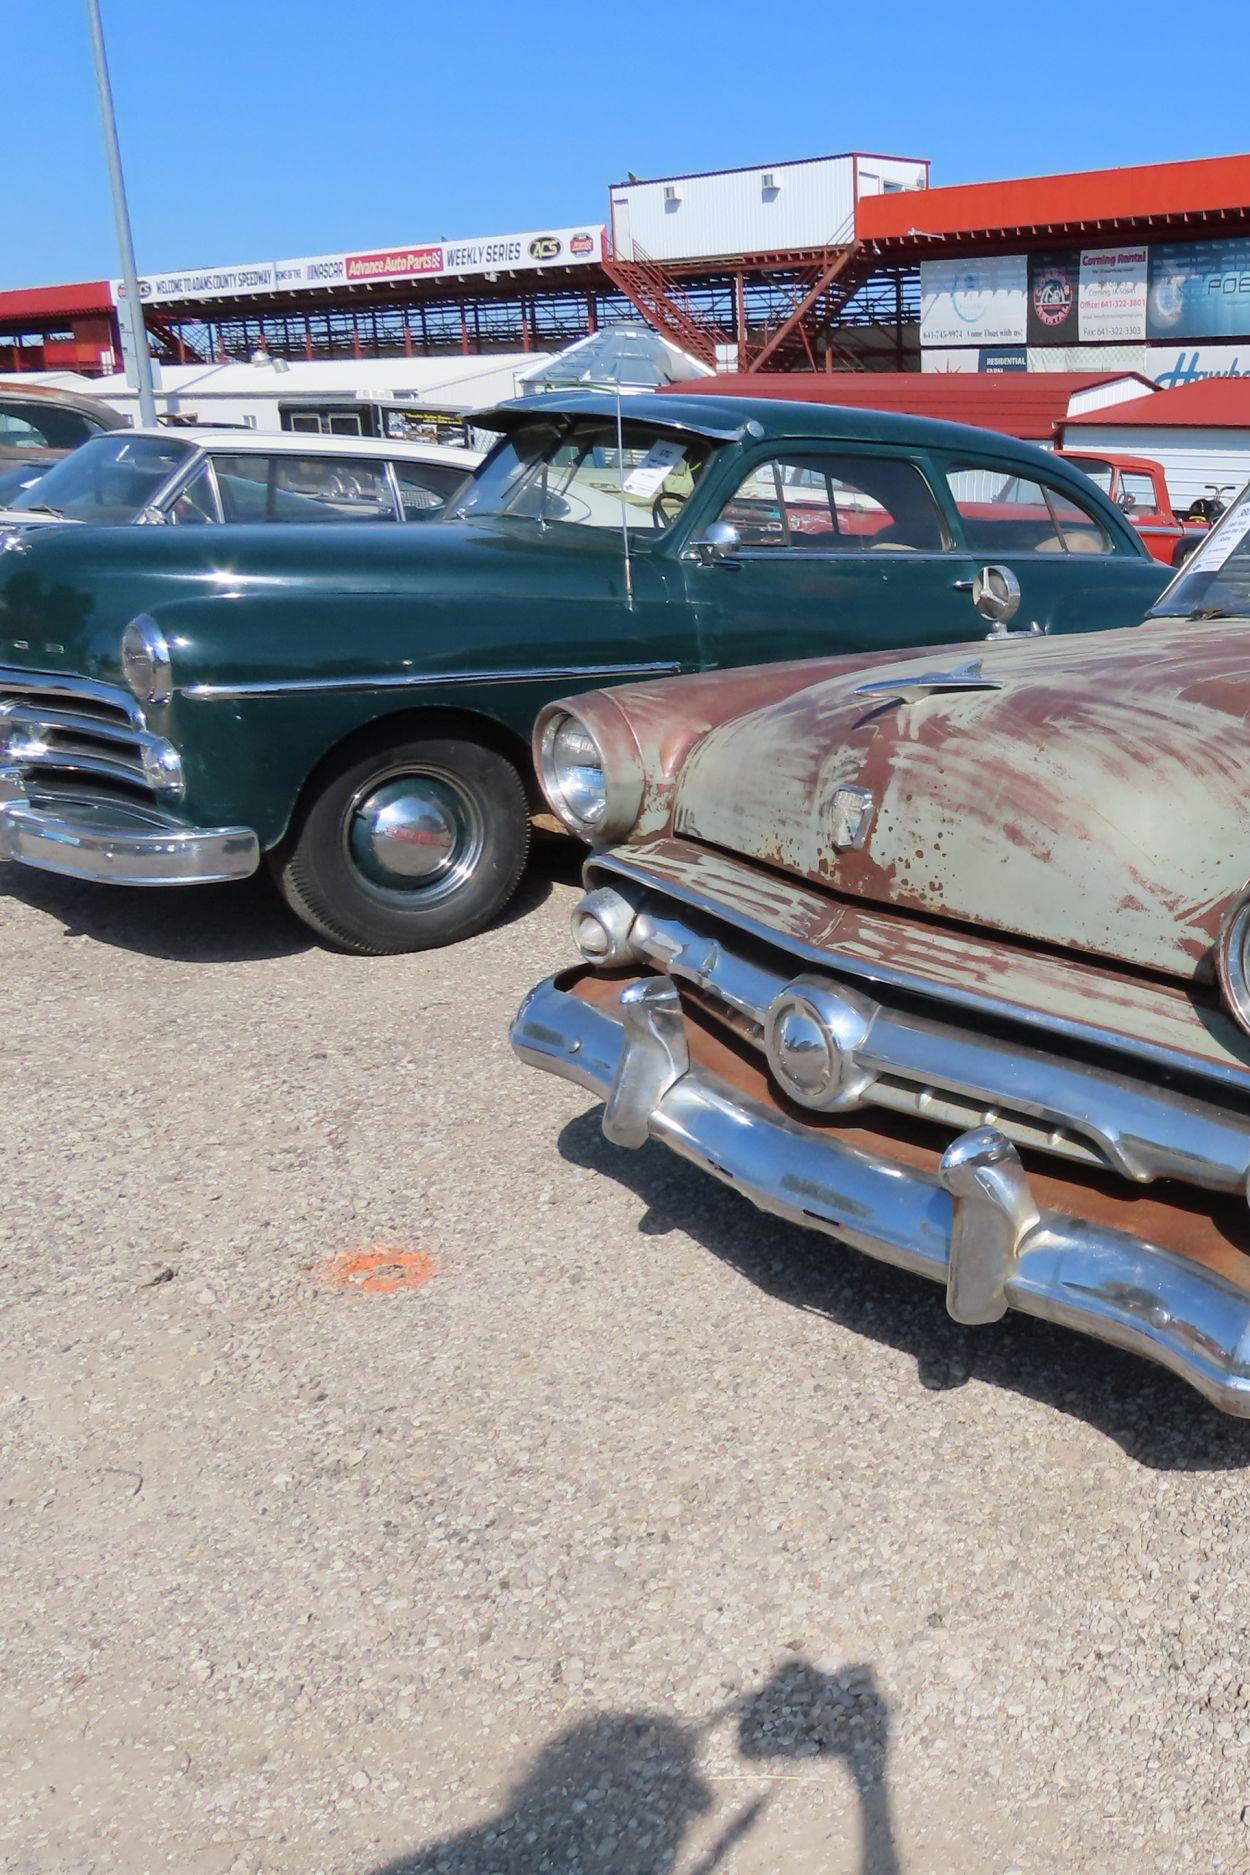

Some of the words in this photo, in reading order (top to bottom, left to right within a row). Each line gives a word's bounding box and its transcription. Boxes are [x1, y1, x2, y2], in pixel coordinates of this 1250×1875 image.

[447, 245, 483, 267] WEEKLY
[486, 242, 521, 263] SERIES
[533, 239, 559, 259] ACS
[1082, 255, 1117, 267] Corning
[1117, 251, 1146, 264] Rental
[311, 262, 344, 280] NASCAR
[350, 259, 384, 276] Advance
[384, 256, 407, 272] Auto
[407, 253, 433, 270] Parts
[156, 279, 183, 294] WELCOME
[184, 277, 191, 292] TO
[192, 275, 213, 292] ADAMS
[213, 273, 237, 290] COUNTY
[238, 269, 272, 288] SPEEDWAY
[986, 357, 1027, 366] RESIDENTIAL
